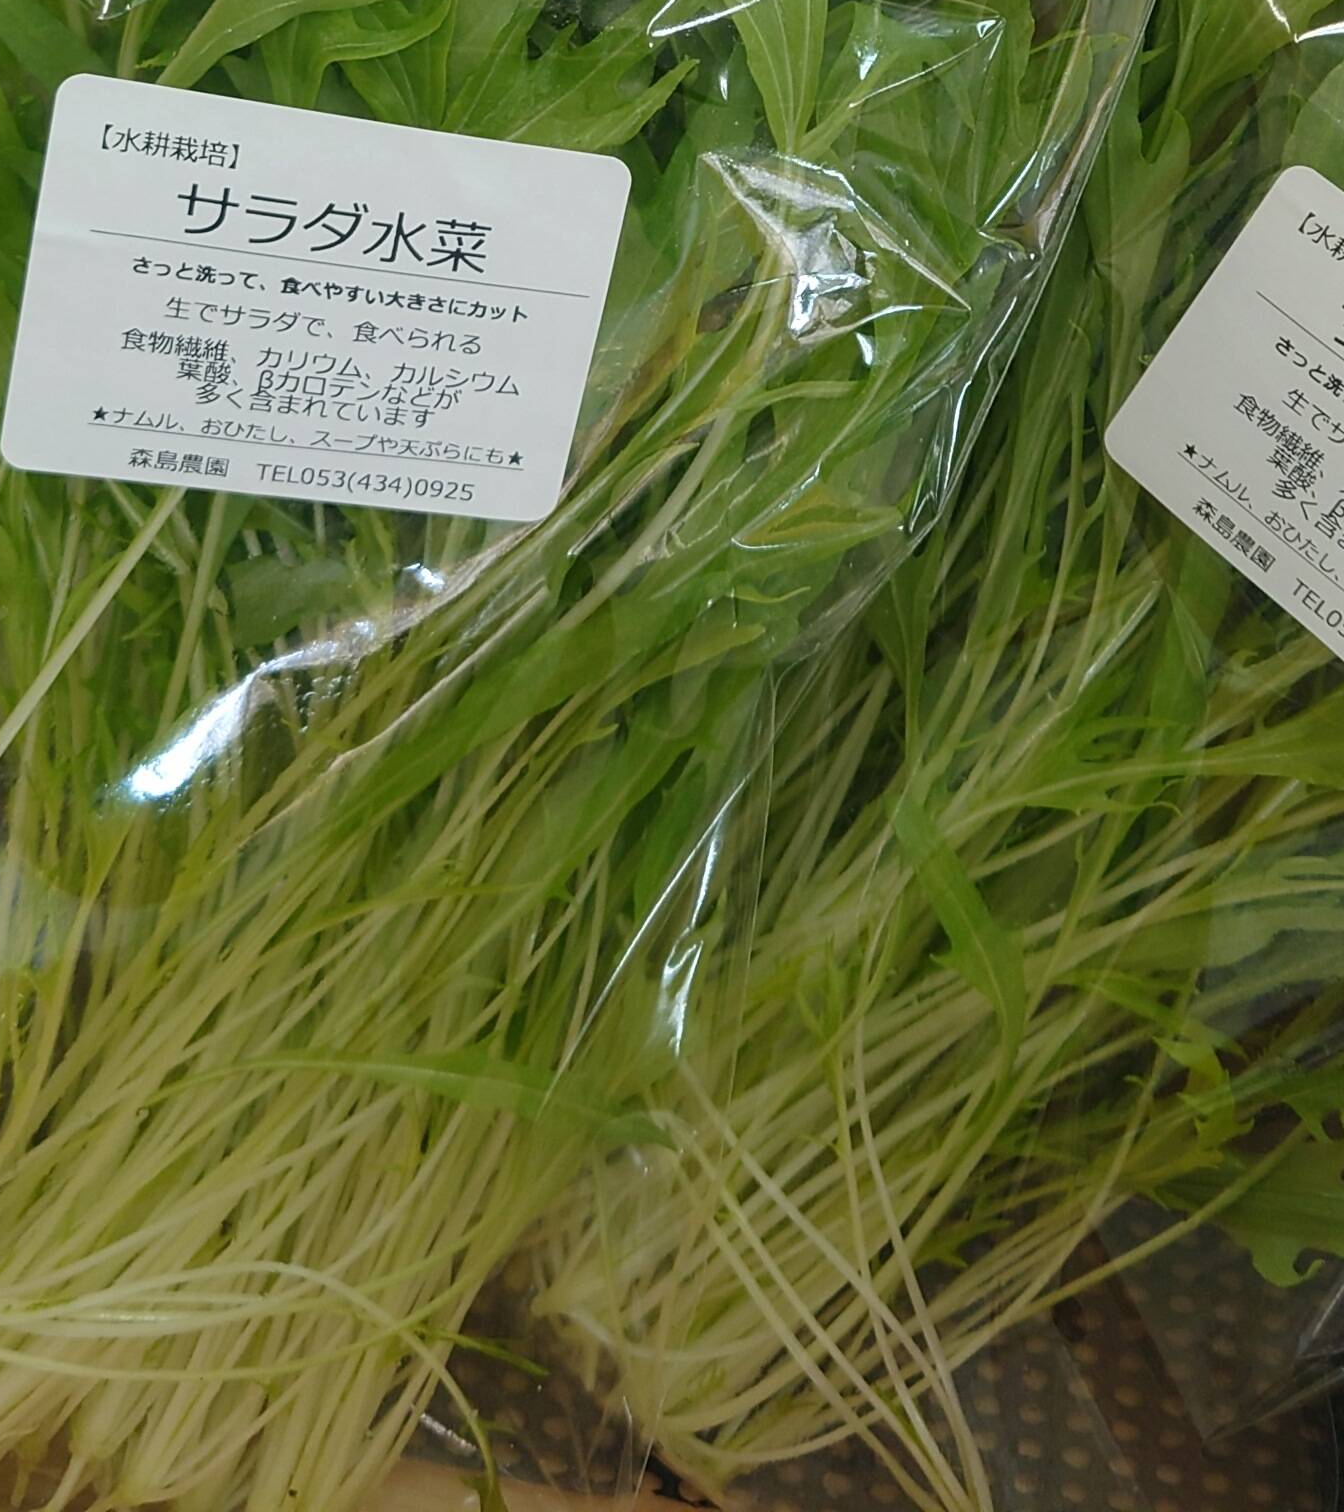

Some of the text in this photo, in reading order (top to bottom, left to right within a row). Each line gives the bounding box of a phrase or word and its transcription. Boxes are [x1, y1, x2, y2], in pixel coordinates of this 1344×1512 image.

[102, 123, 241, 170] 【水耕栽培】
[177, 182, 494, 274] サラダ水菜
[132, 256, 530, 324] さっと洗って、食べやすい大きさにカット
[166, 296, 482, 356] 生でサラダで、食べられる
[195, 381, 436, 429] 多く含まれています
[128, 447, 475, 502] 森島農園 TEL053(434)0925
[1192, 496, 1276, 573] 森島農園
